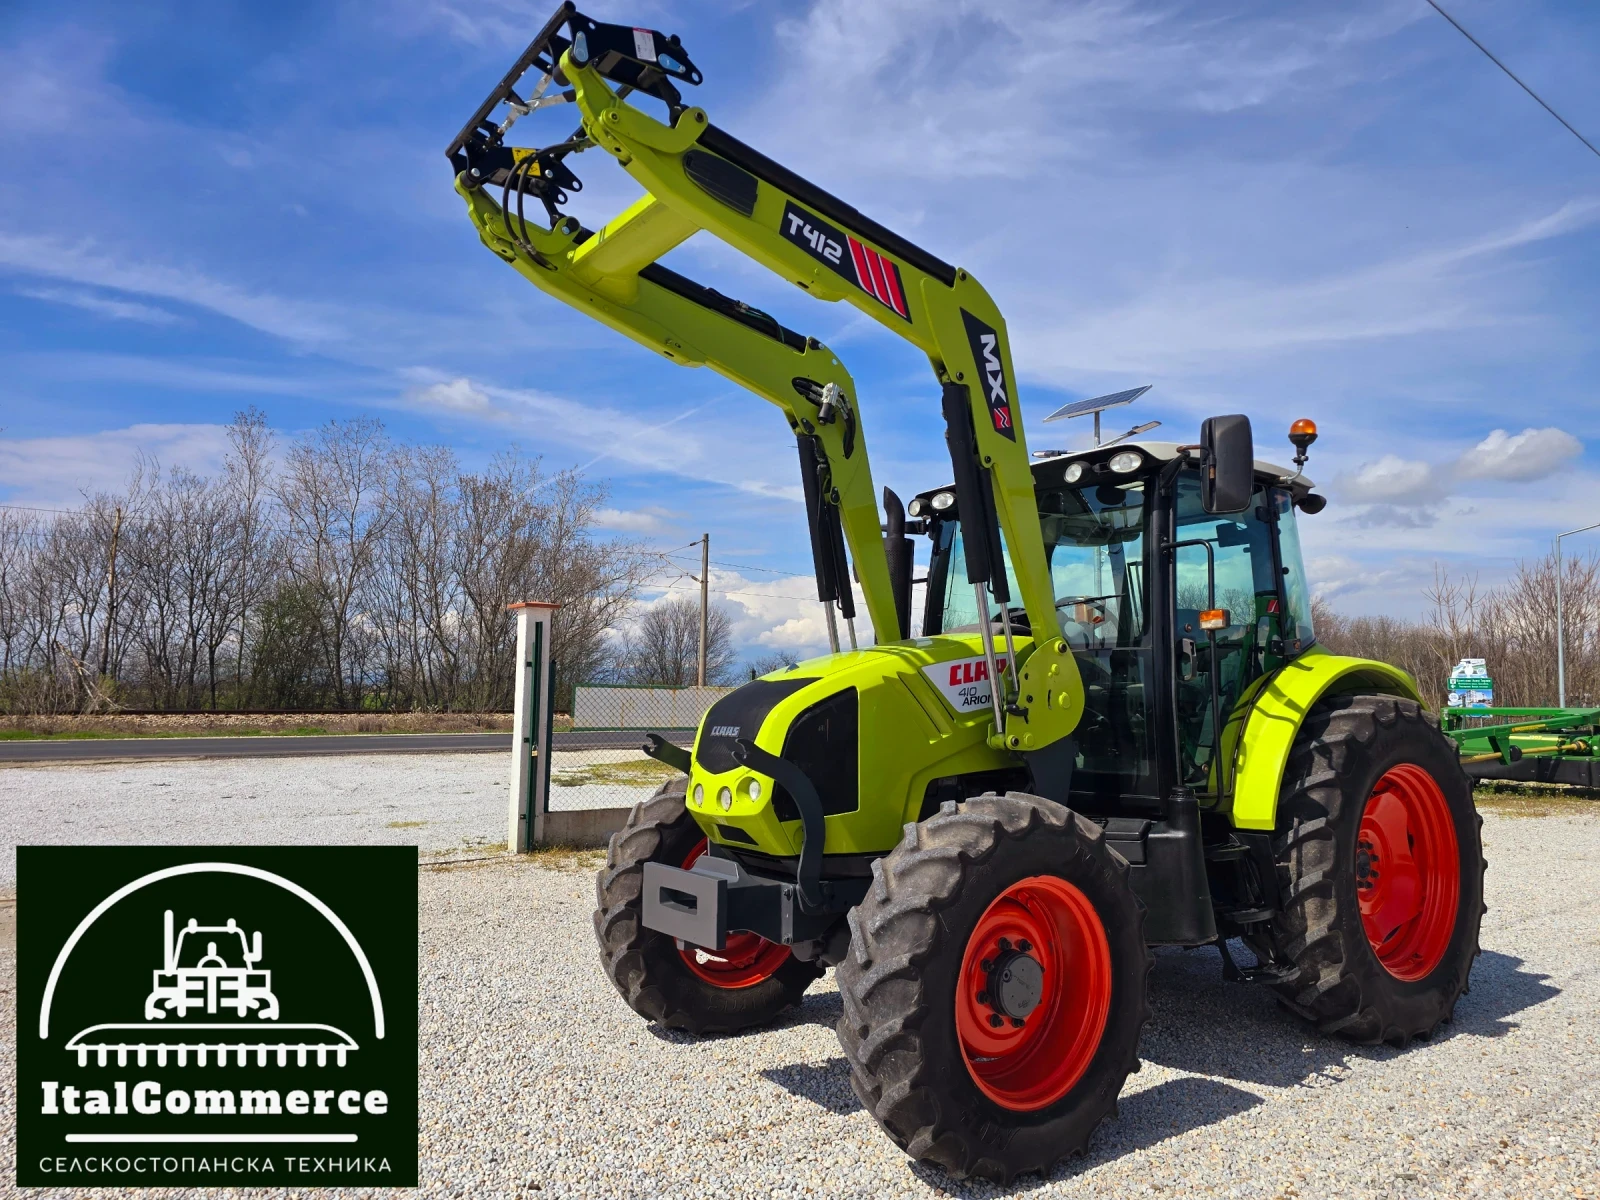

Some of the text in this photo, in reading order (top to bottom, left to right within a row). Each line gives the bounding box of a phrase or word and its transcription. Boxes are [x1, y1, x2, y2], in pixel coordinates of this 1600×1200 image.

[788, 212, 843, 265] T412
[980, 333, 1007, 404] MX
[958, 686, 978, 697] 410
[710, 725, 741, 737] CLAAS
